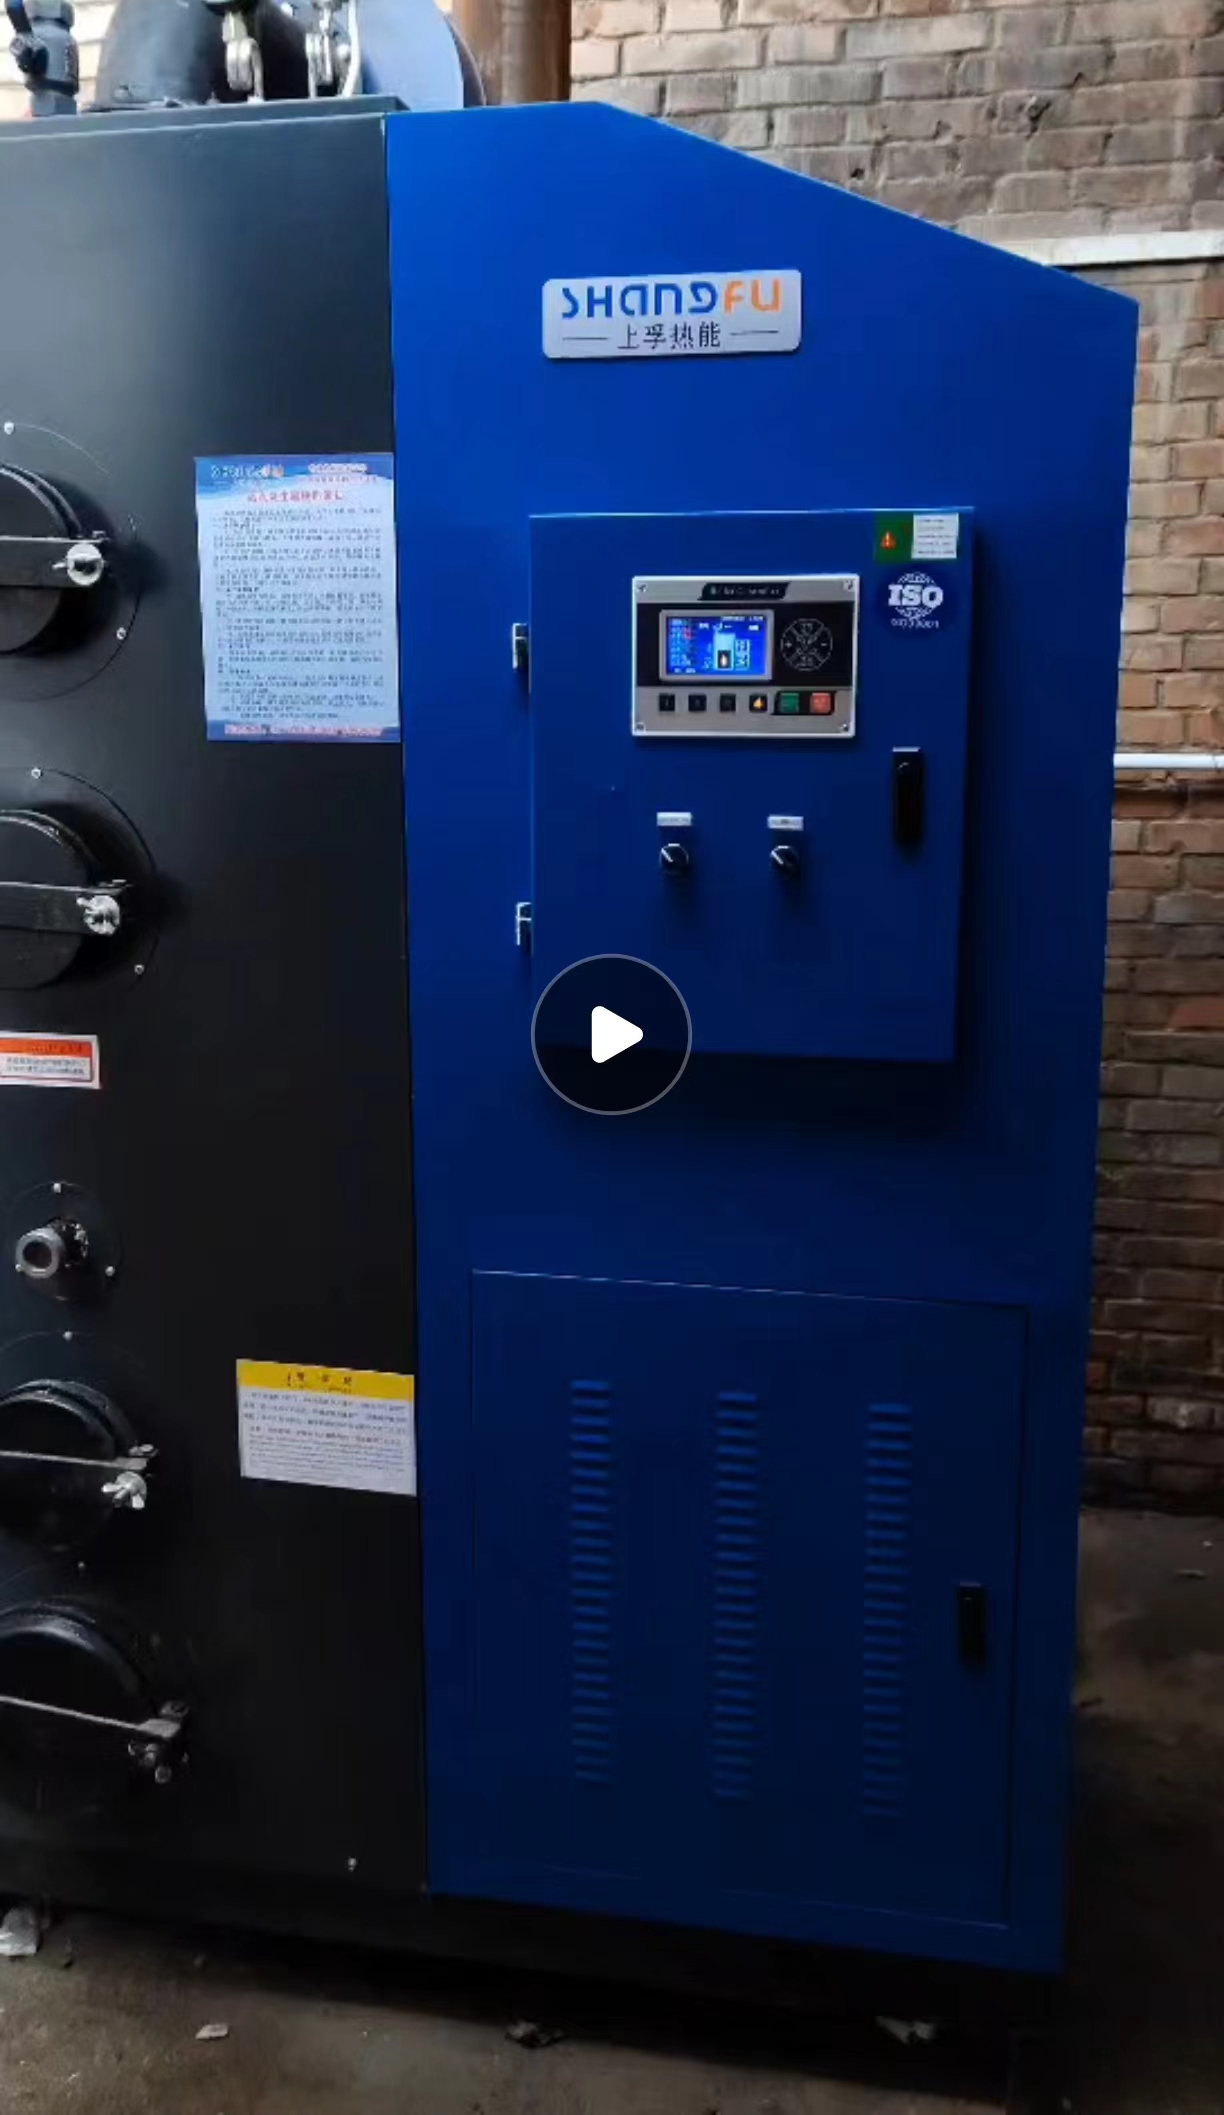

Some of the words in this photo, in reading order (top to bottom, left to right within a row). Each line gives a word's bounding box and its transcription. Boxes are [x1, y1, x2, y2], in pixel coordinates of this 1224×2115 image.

[617, 321, 721, 349] 上孚热能
[888, 584, 943, 608] ISO
